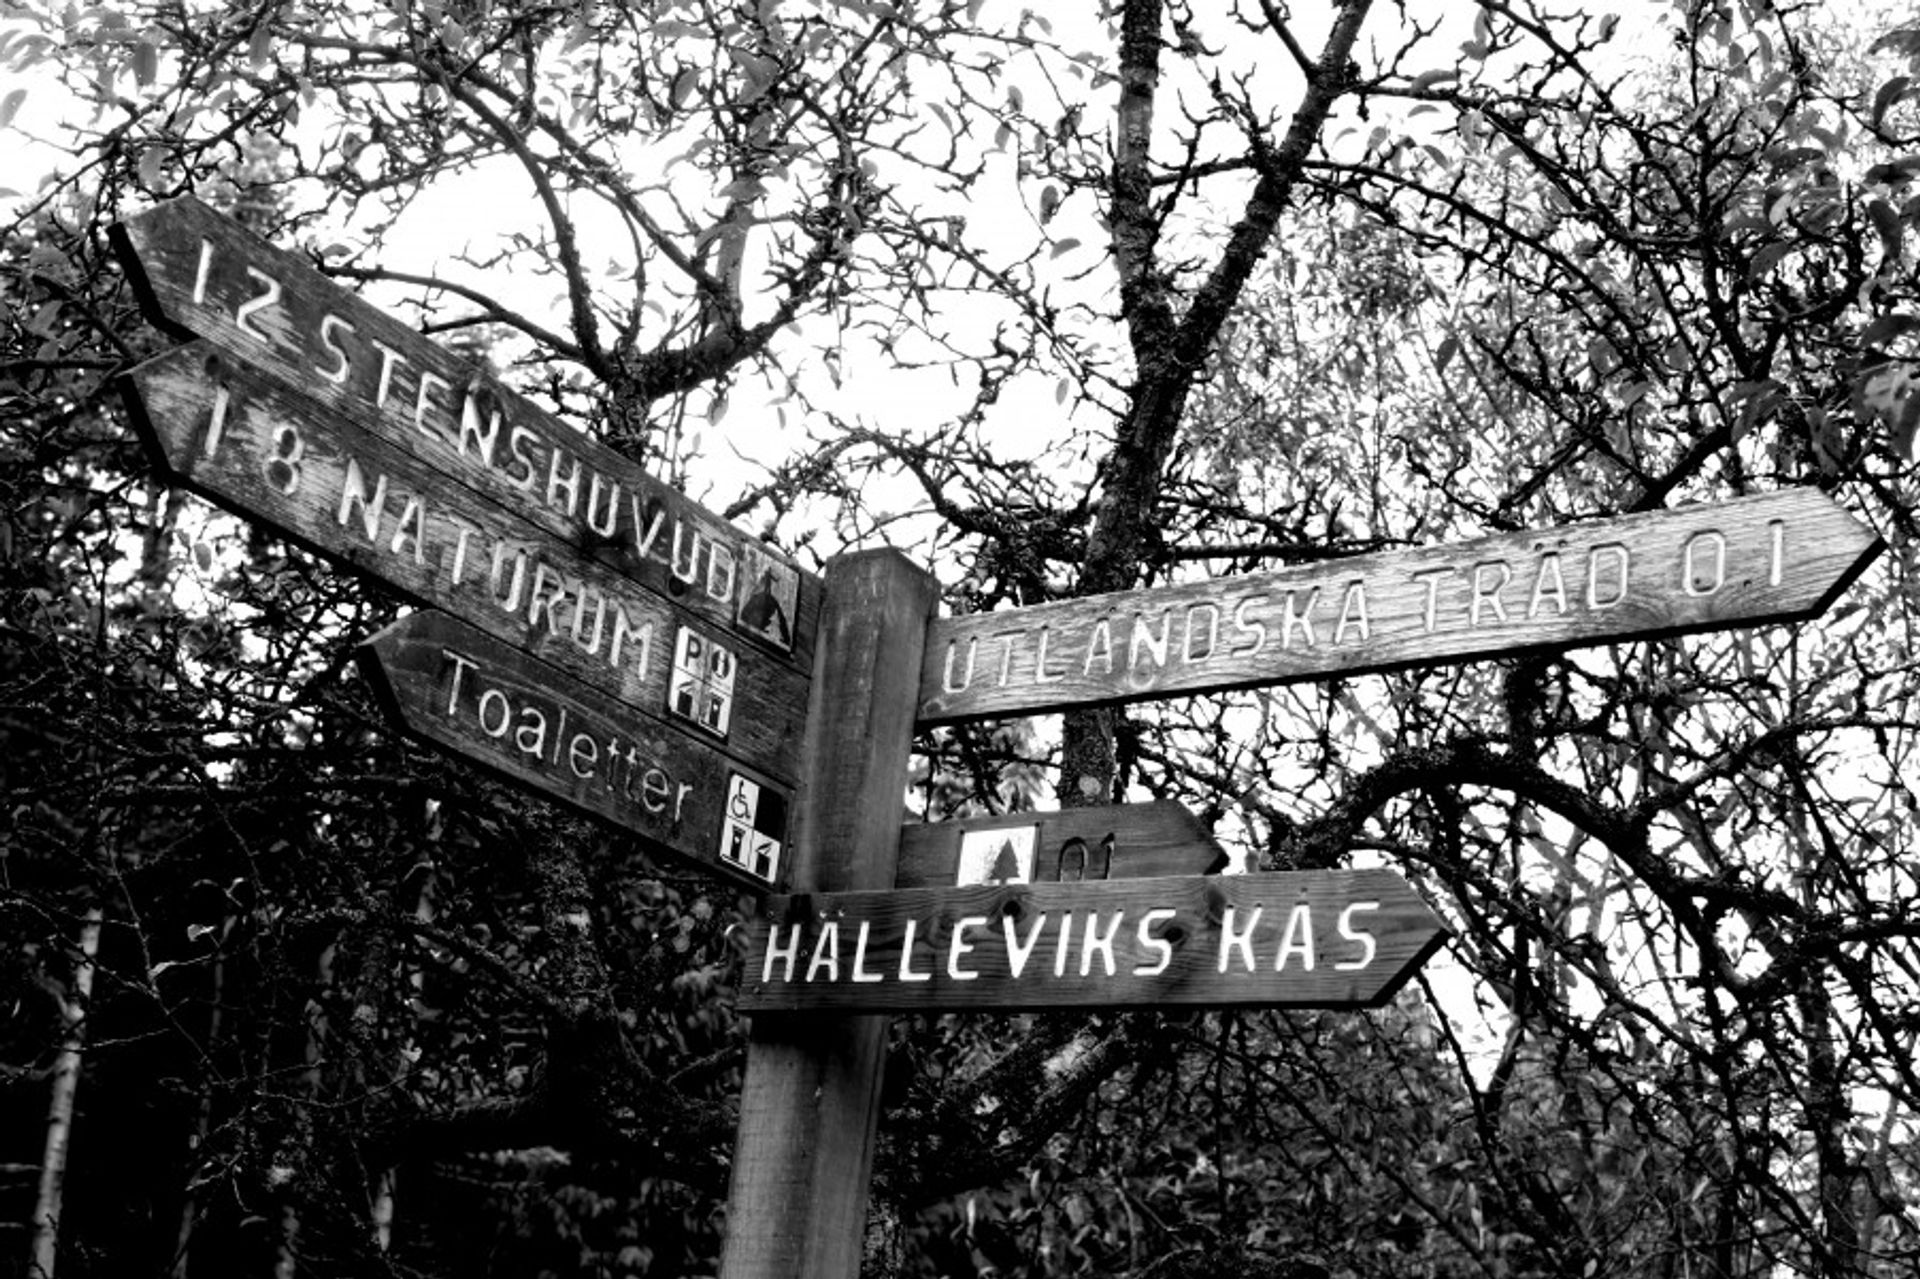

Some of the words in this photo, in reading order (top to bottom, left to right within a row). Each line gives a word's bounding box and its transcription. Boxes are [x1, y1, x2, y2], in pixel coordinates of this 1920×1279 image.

[314, 313, 736, 603] STENSHUVUD
[338, 456, 653, 682] NATURUM
[1412, 539, 1630, 633] TRÄD
[441, 647, 694, 823] Toaletter
[761, 907, 1177, 983] HÄLLEVIKS
